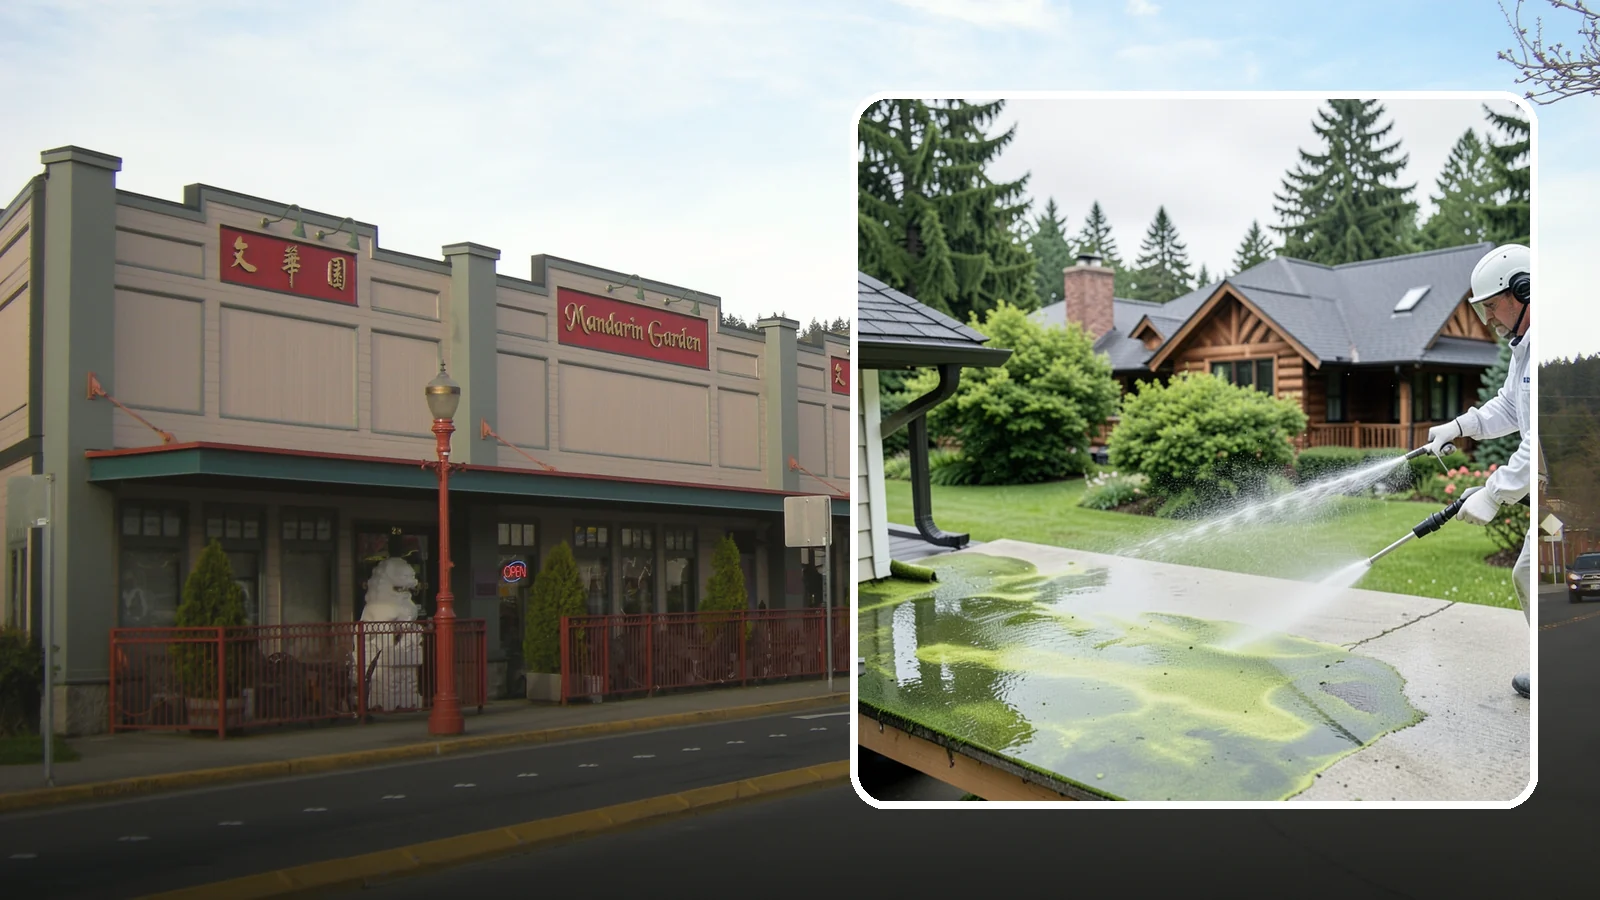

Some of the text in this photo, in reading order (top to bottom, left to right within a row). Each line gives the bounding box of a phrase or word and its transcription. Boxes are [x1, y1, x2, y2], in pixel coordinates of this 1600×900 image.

[231, 236, 346, 290] 文華園
[565, 302, 701, 352] Mandarin Garden
[503, 565, 526, 578] OPEN
